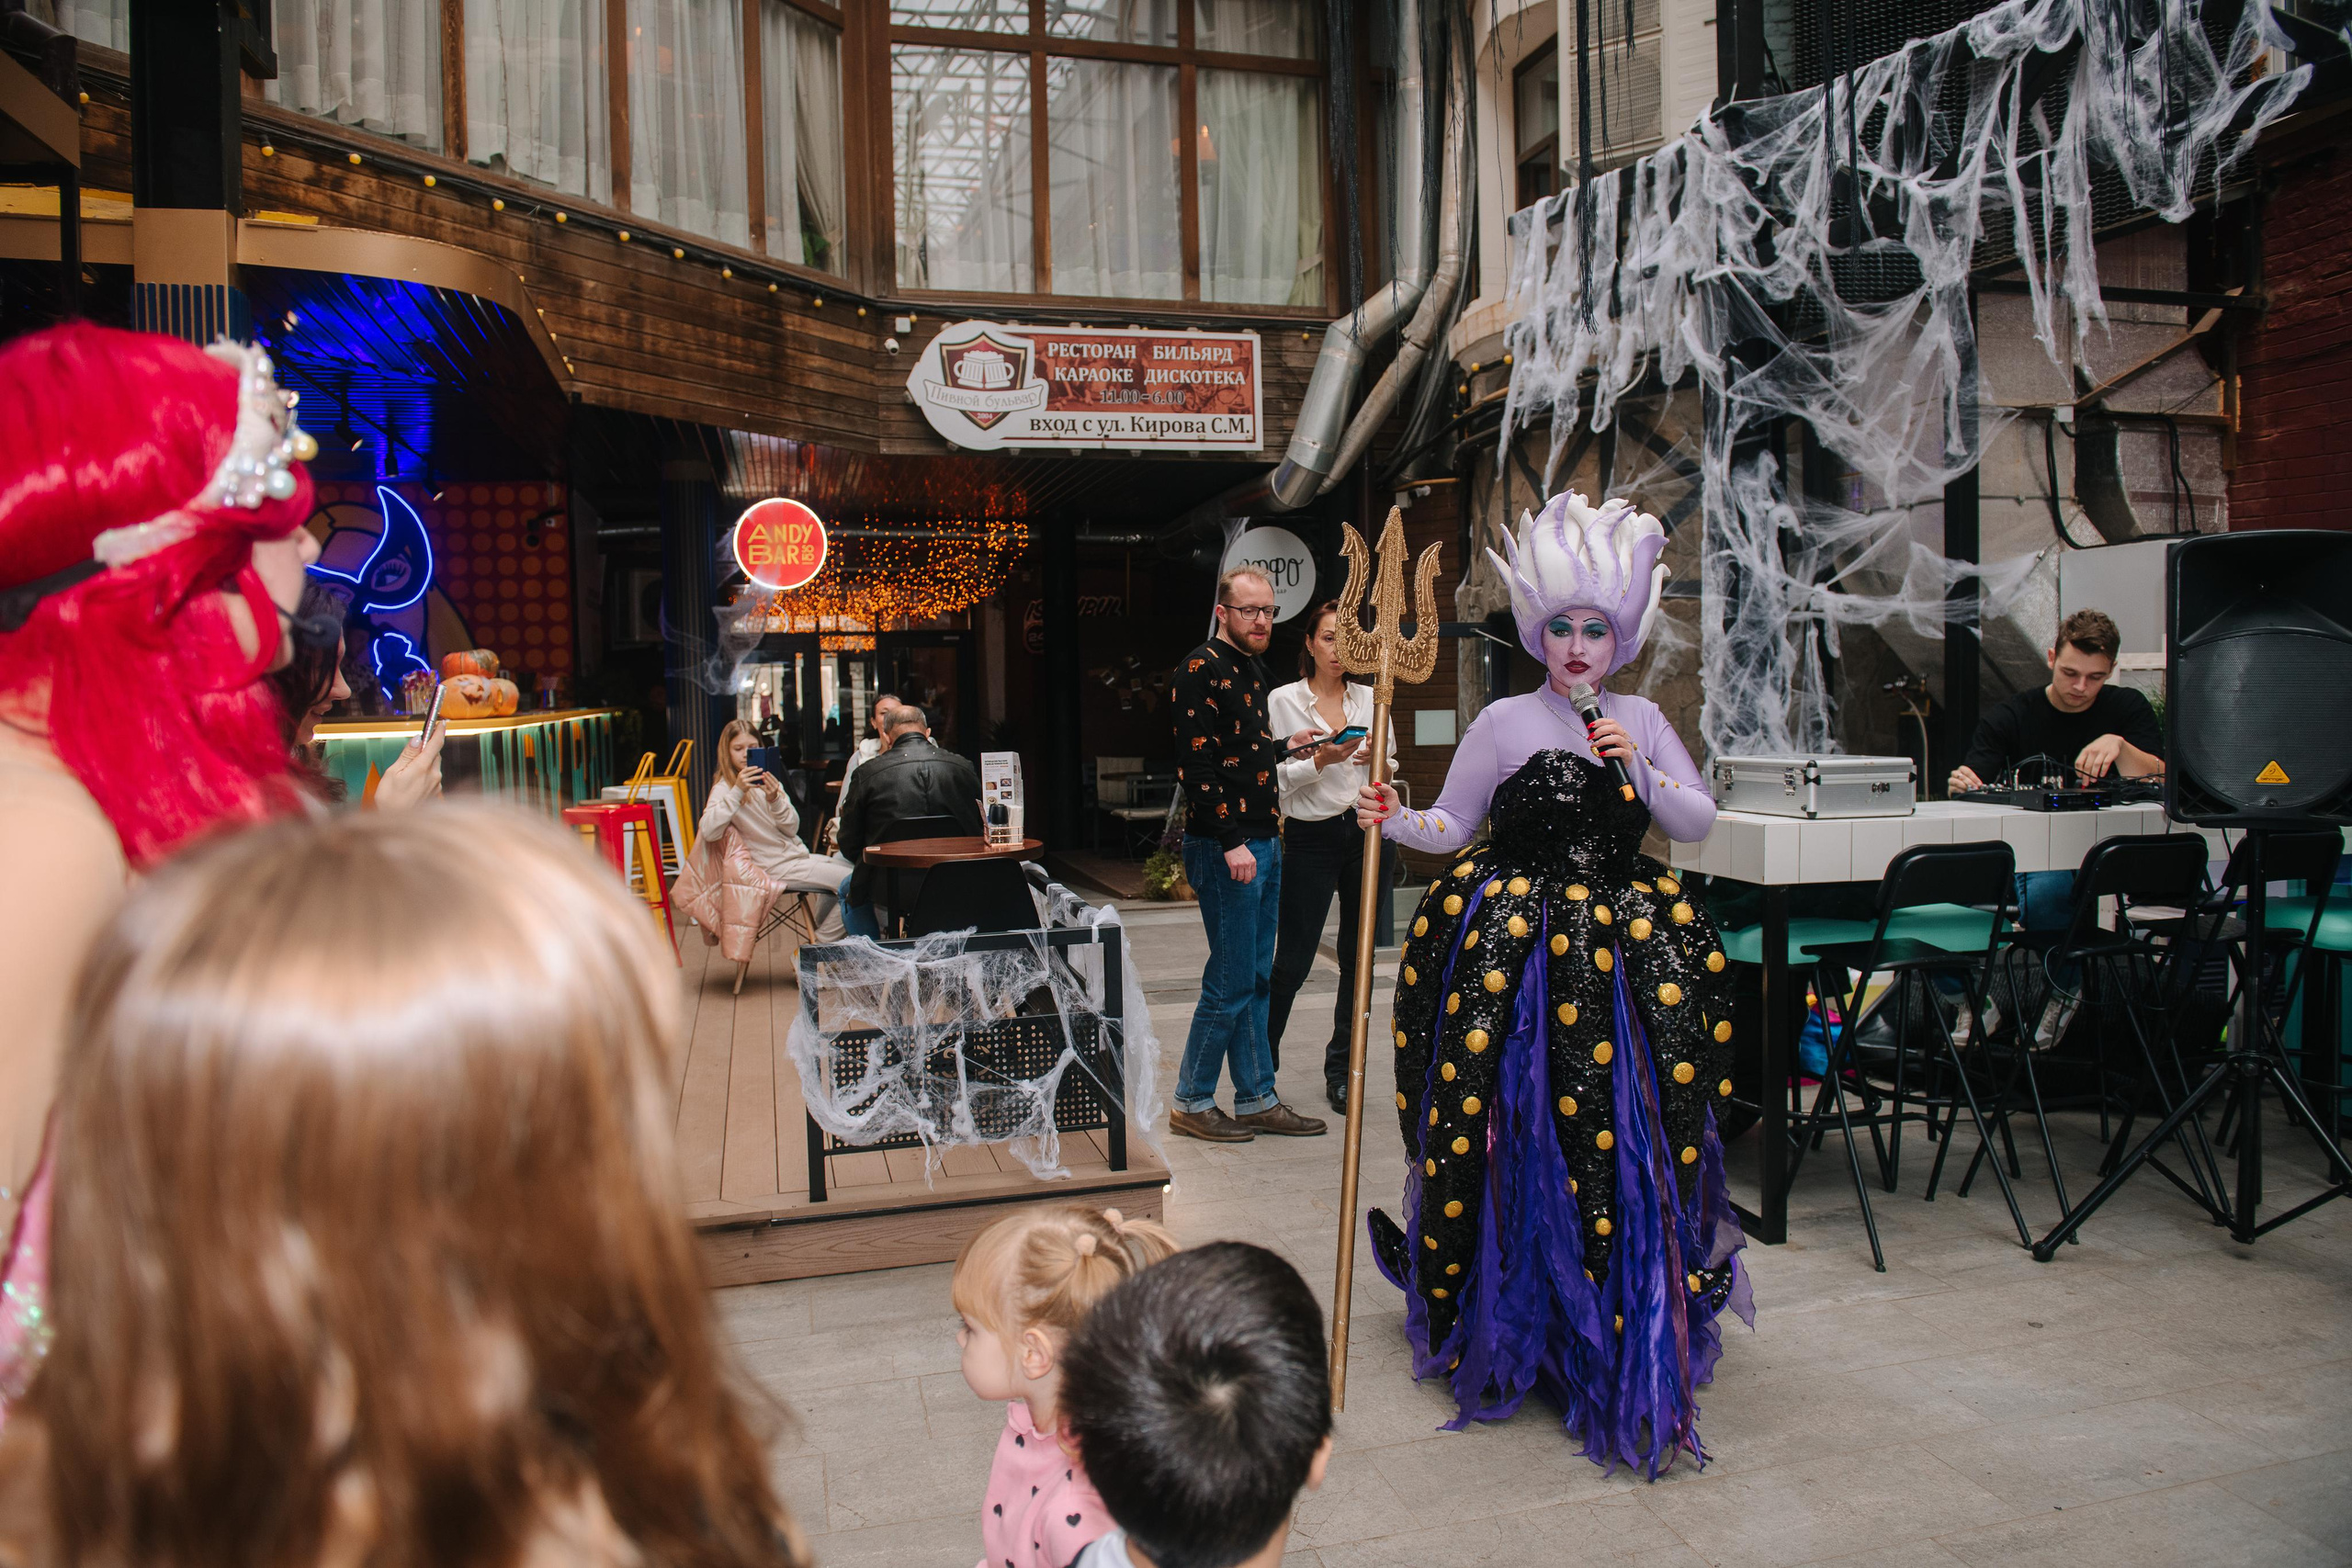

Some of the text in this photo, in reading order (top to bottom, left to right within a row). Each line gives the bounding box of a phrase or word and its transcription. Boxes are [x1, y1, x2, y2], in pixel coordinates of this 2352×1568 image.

[1047, 342, 1234, 365] РЕСТОРАН БИЛЬЯРД
[1054, 367, 1246, 386] КАРАОКЕ ДИСКОТЕКА
[930, 384, 1038, 410] Пивной бульвар
[1030, 416, 1250, 437] вход с ул. Кирова С.М.
[747, 524, 814, 544] ANDY
[748, 544, 799, 565] BAR
